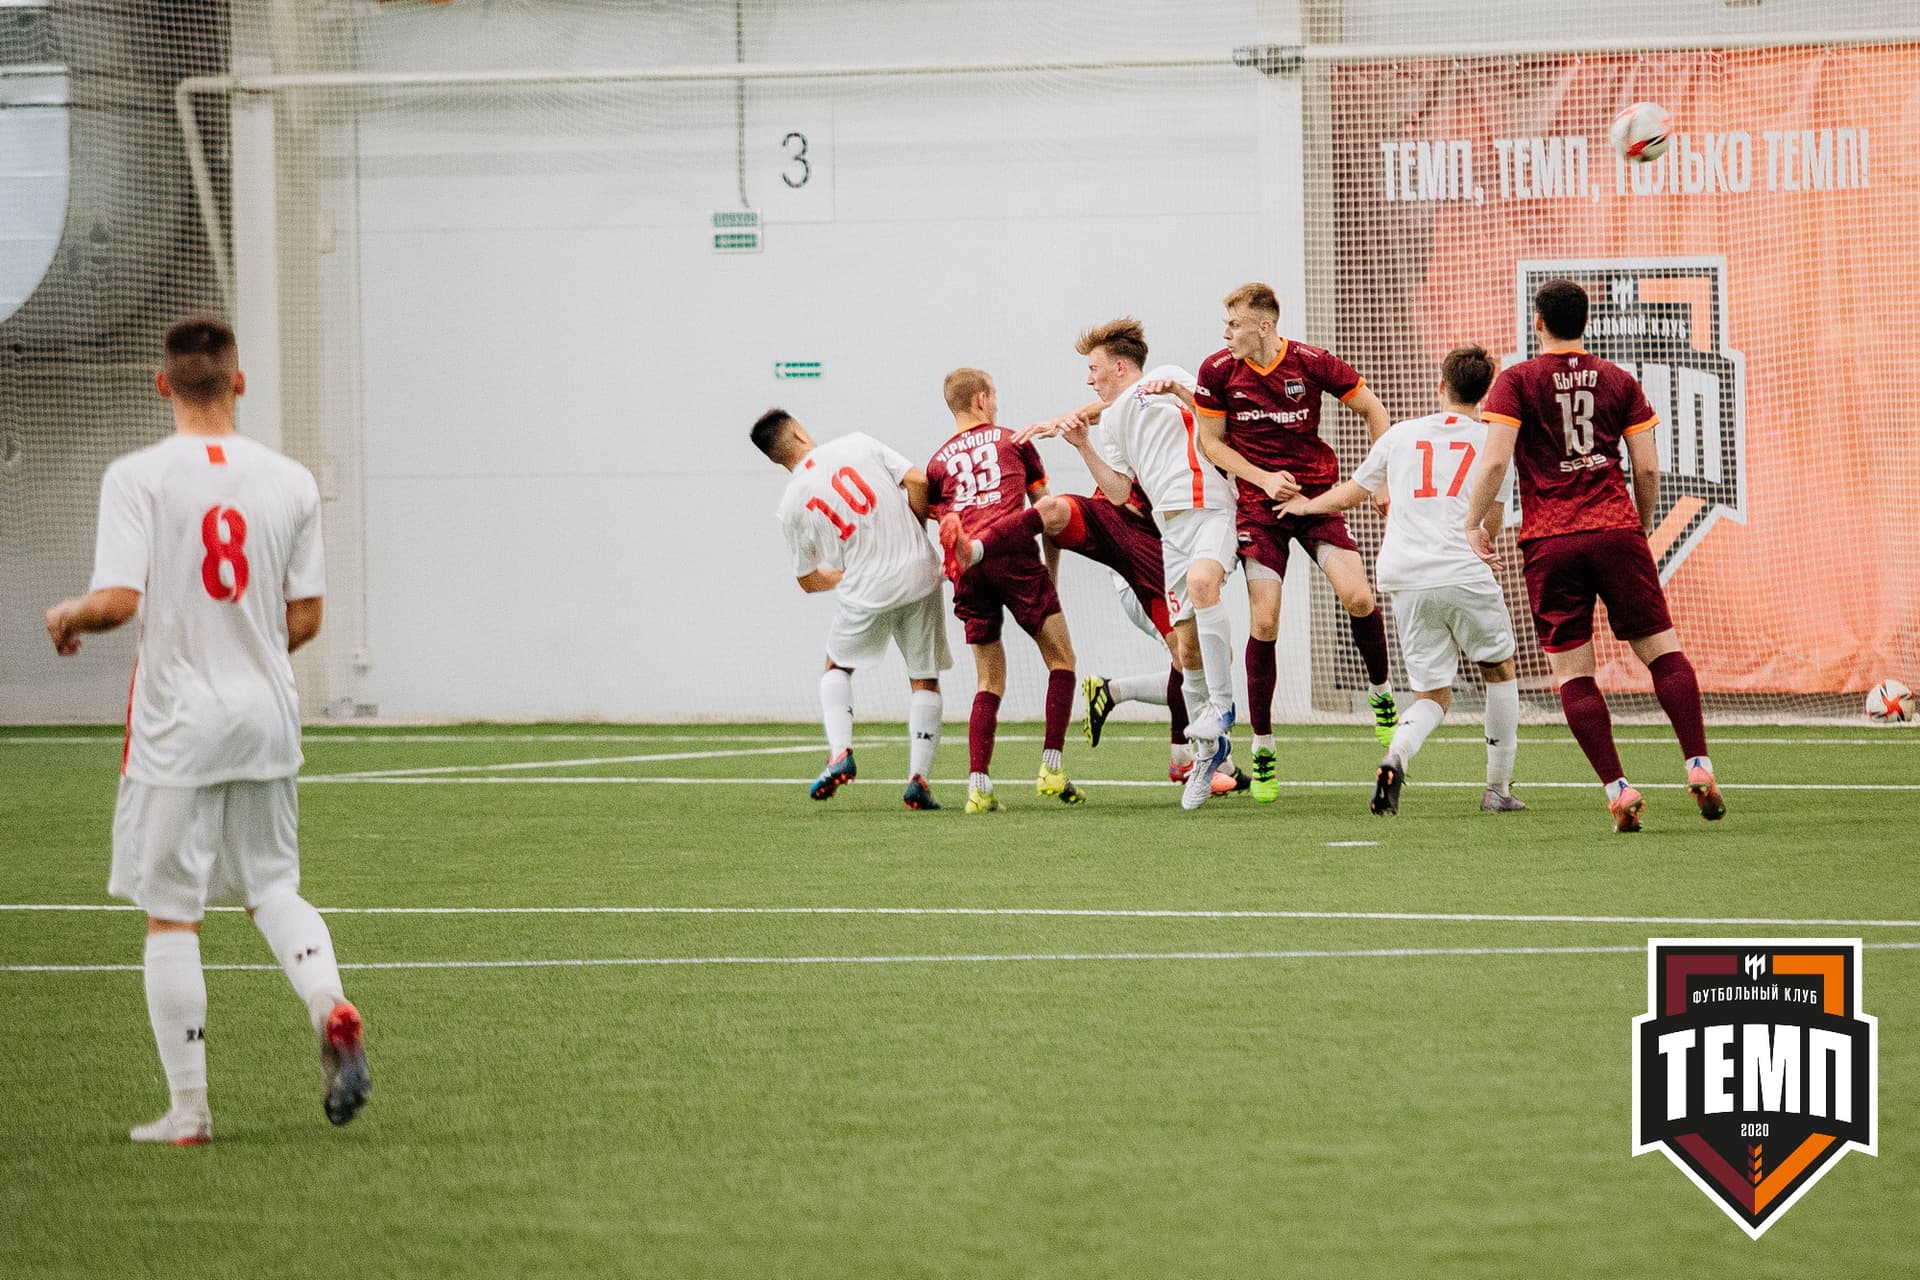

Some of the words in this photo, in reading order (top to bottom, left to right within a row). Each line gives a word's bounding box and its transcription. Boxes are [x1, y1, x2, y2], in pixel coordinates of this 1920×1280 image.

[782, 132, 810, 188] 3
[1382, 140, 1484, 206] ТЕМП,
[1494, 136, 1600, 204] ТЕМП,
[1763, 127, 1869, 192] ТЕМП!
[1553, 370, 1598, 390] СЫЧЕВ
[1555, 390, 1595, 456] 13
[947, 443, 1002, 500] 33
[1414, 441, 1476, 498] 17
[806, 466, 877, 541] 10
[201, 503, 249, 604] 8
